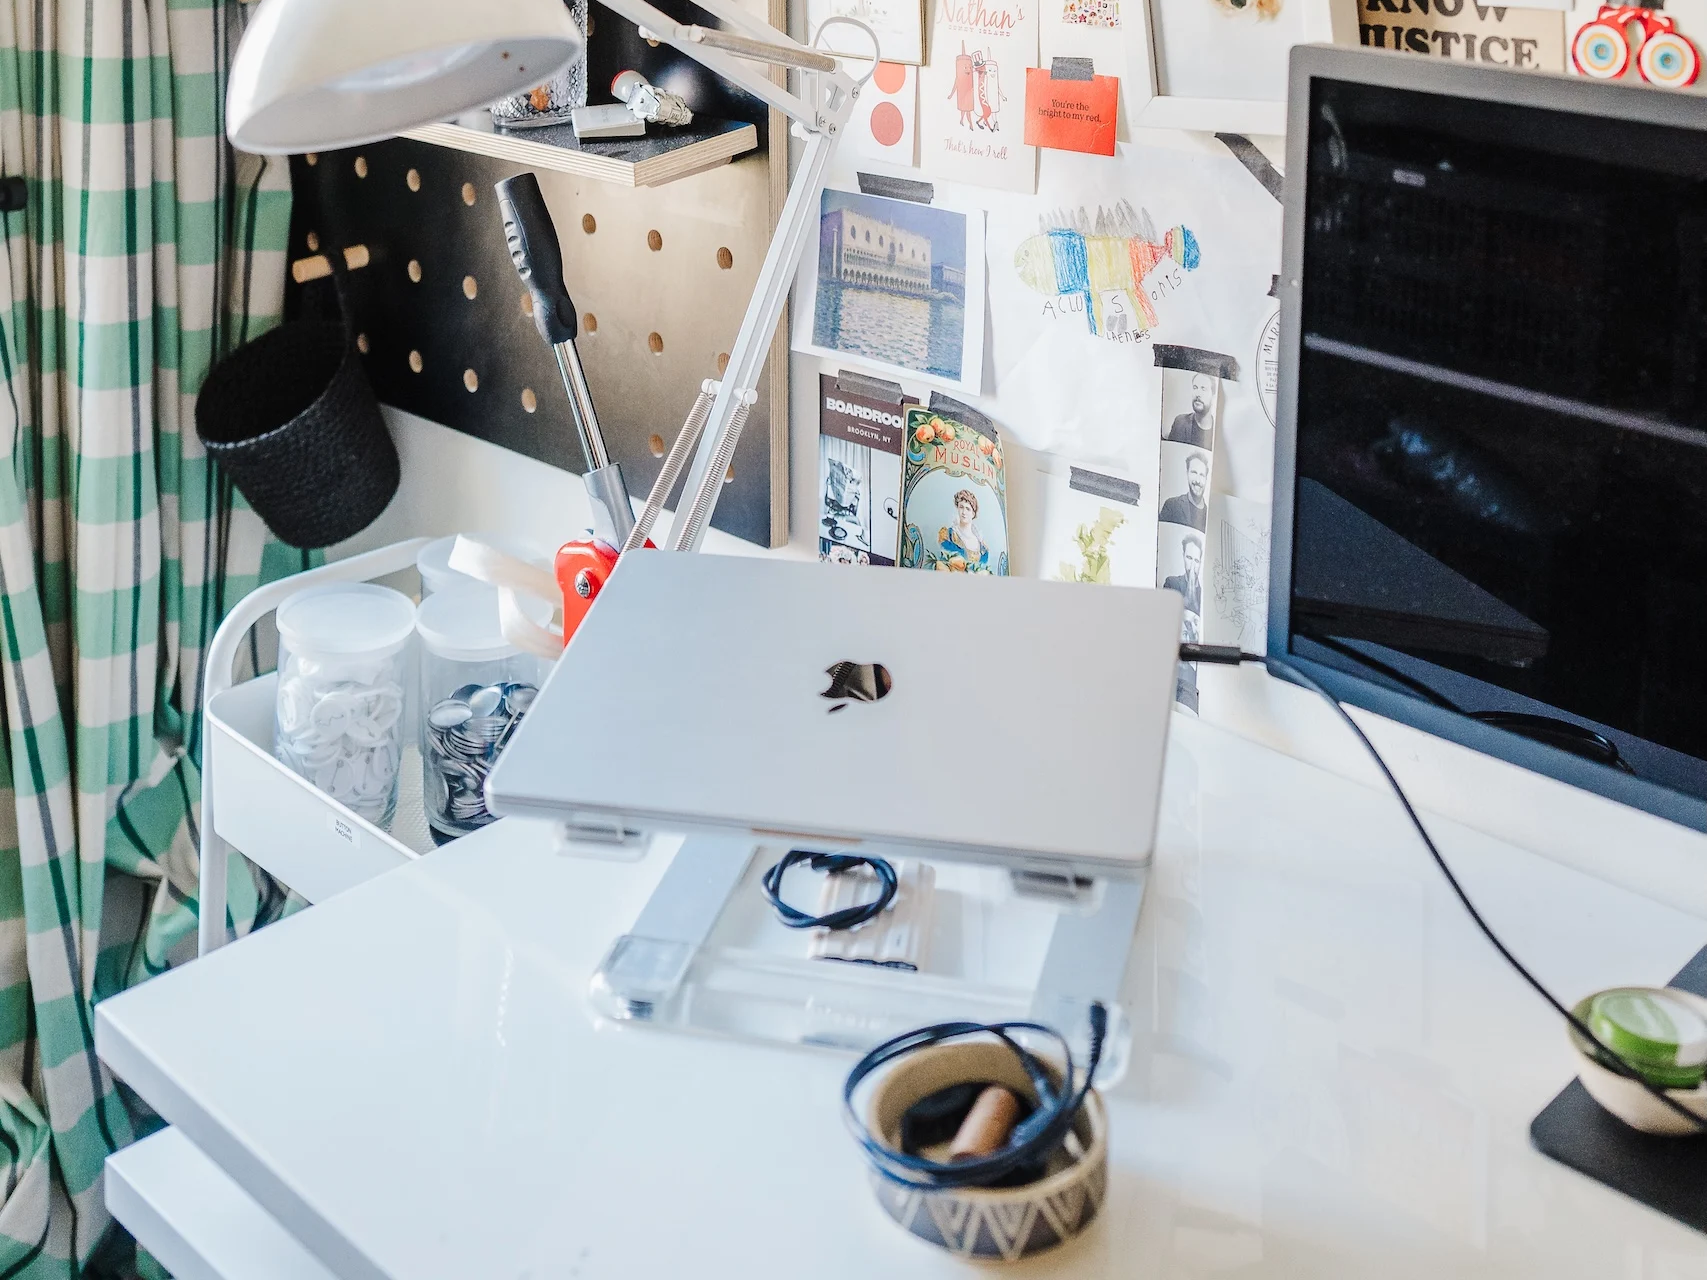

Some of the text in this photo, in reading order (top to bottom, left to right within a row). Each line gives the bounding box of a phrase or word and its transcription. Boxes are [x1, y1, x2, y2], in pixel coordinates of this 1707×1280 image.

[979, 29, 1010, 37] ISLAND
[1038, 107, 1102, 123] bright to my red.
[1051, 99, 1090, 112] You're the
[944, 136, 1008, 160] That's how I roll
[826, 396, 903, 429] BOARDROO
[847, 426, 892, 444] BROOKLYN, NY
[953, 439, 980, 460] ROYAL
[934, 445, 994, 480] MUSLIN
